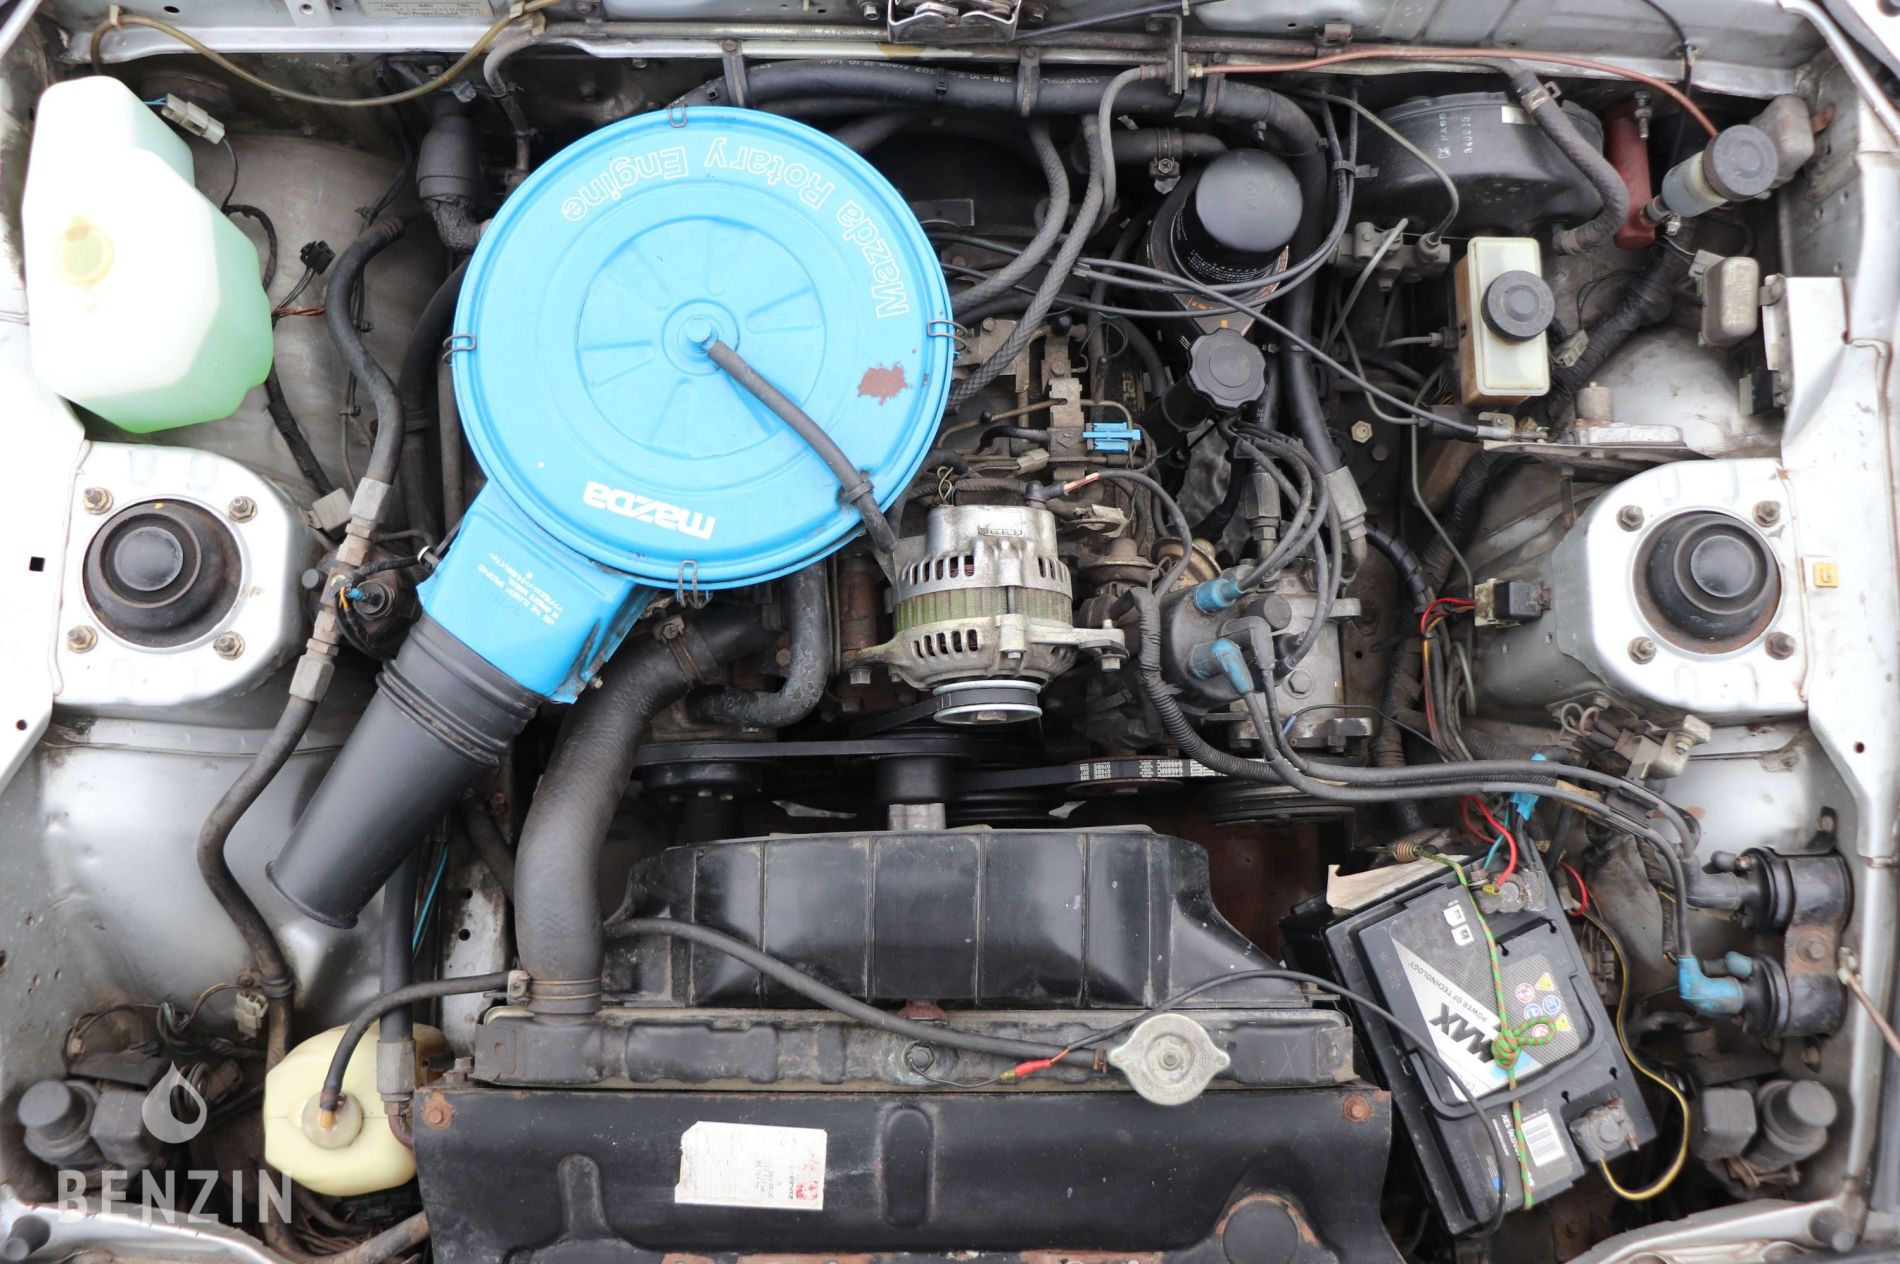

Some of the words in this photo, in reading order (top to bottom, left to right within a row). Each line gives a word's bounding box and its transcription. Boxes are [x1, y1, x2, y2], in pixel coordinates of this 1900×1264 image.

[561, 146, 689, 222] Engine
[704, 137, 836, 211] Rotary
[836, 200, 910, 319] Mazda
[1409, 960, 1452, 997] TECHNOLOGY
[1452, 993, 1463, 1005] OF
[1463, 1001, 1488, 1023] POWER
